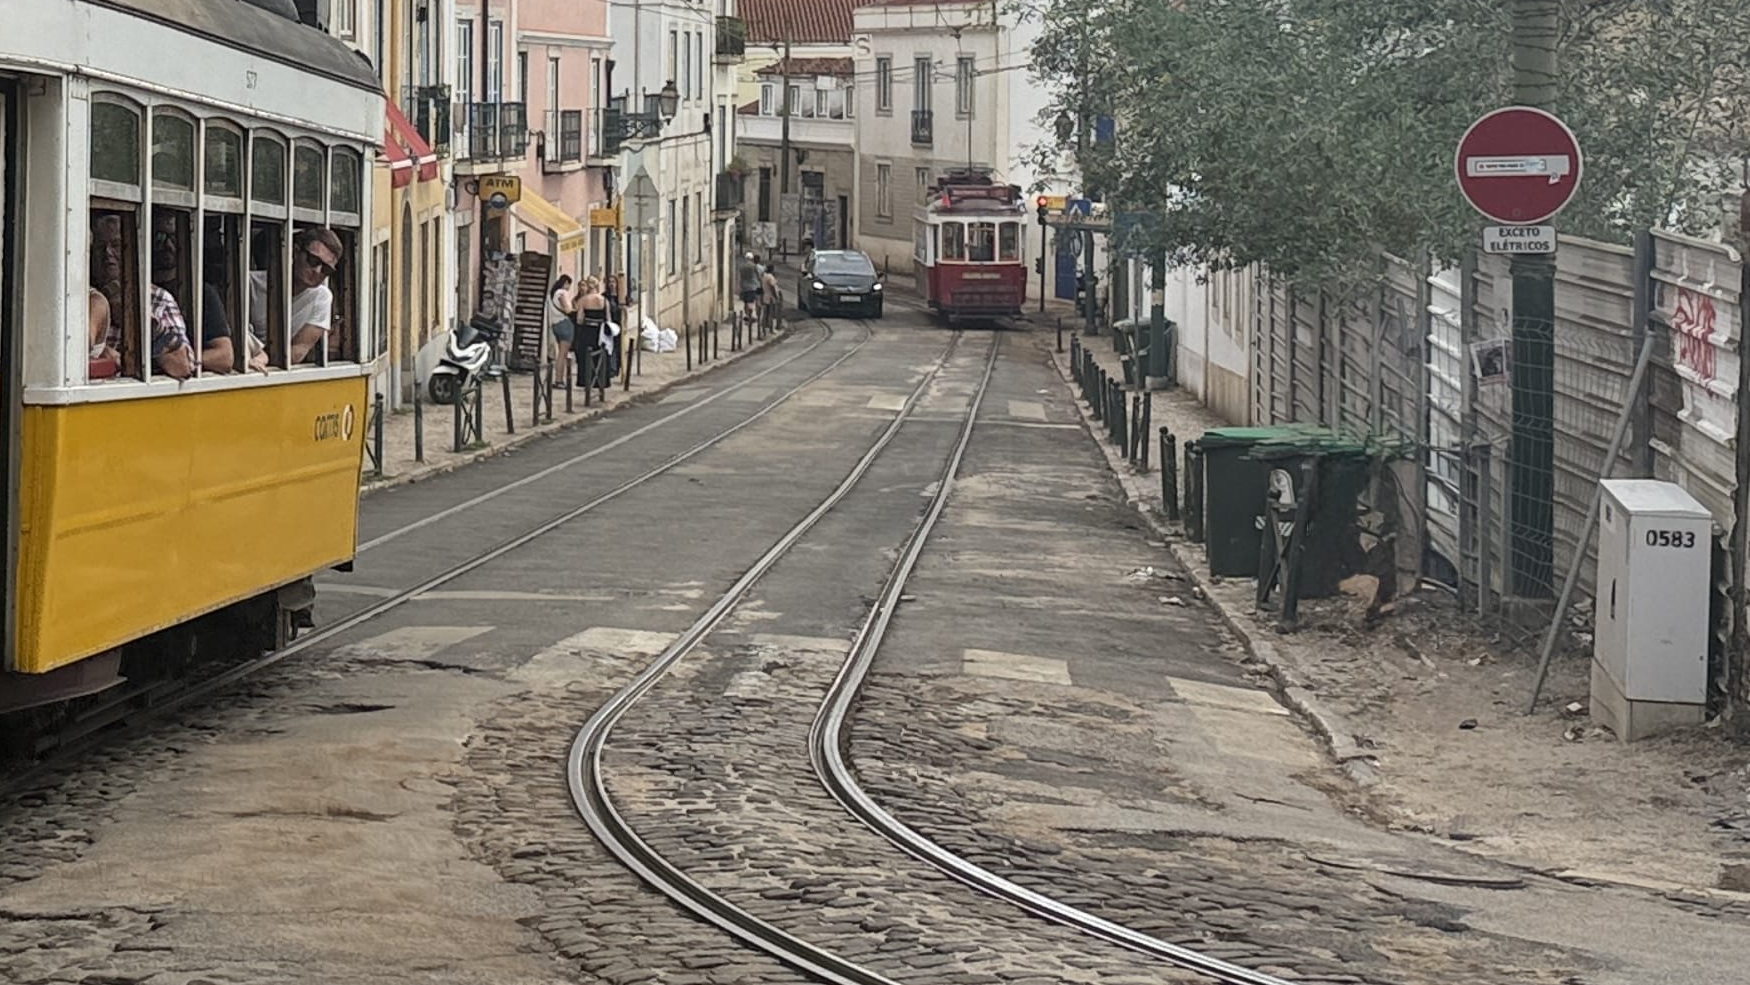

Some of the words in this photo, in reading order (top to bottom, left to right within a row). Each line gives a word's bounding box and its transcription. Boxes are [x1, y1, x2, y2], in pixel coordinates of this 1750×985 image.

[485, 178, 514, 188] ATM
[1498, 227, 1540, 237] EXCETO
[1490, 239, 1550, 251] ELÉTRICOS
[1646, 529, 1696, 549] 0583
